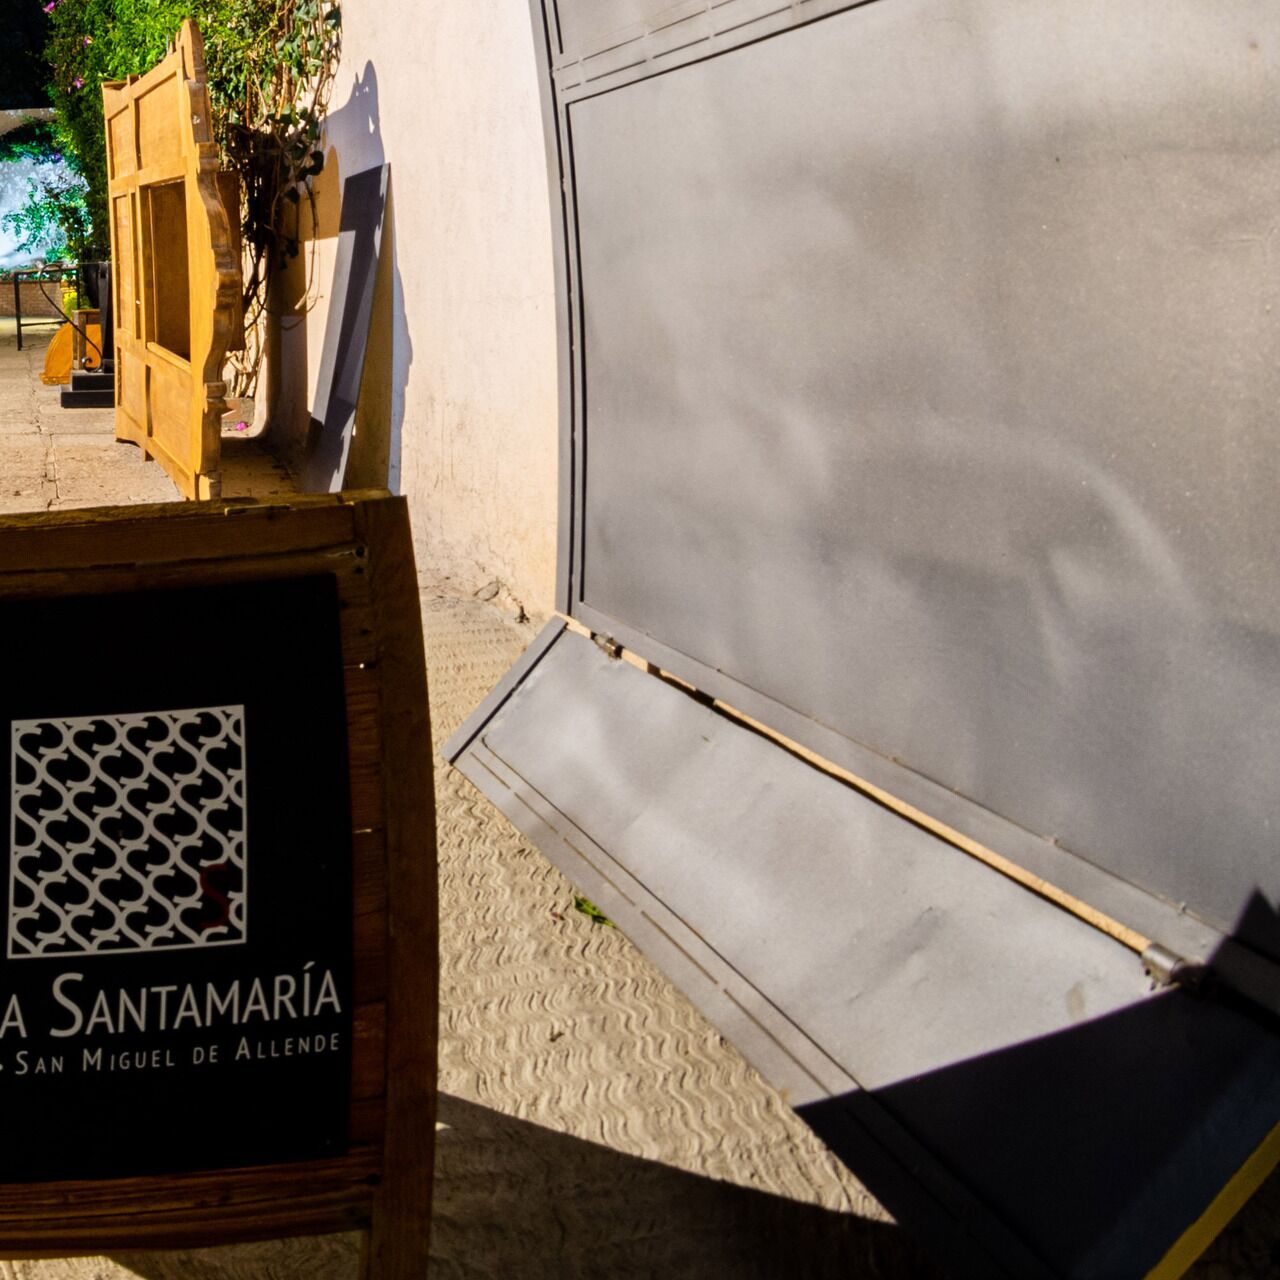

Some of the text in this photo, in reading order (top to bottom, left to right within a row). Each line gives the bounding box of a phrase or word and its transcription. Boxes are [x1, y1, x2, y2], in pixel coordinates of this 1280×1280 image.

[49, 961, 341, 1038] SANTAMARÍA
[15, 1051, 64, 1075] SAN
[82, 1044, 175, 1072] MIGUEL
[193, 1044, 218, 1065] DE
[235, 1032, 340, 1061] ALLENDE
